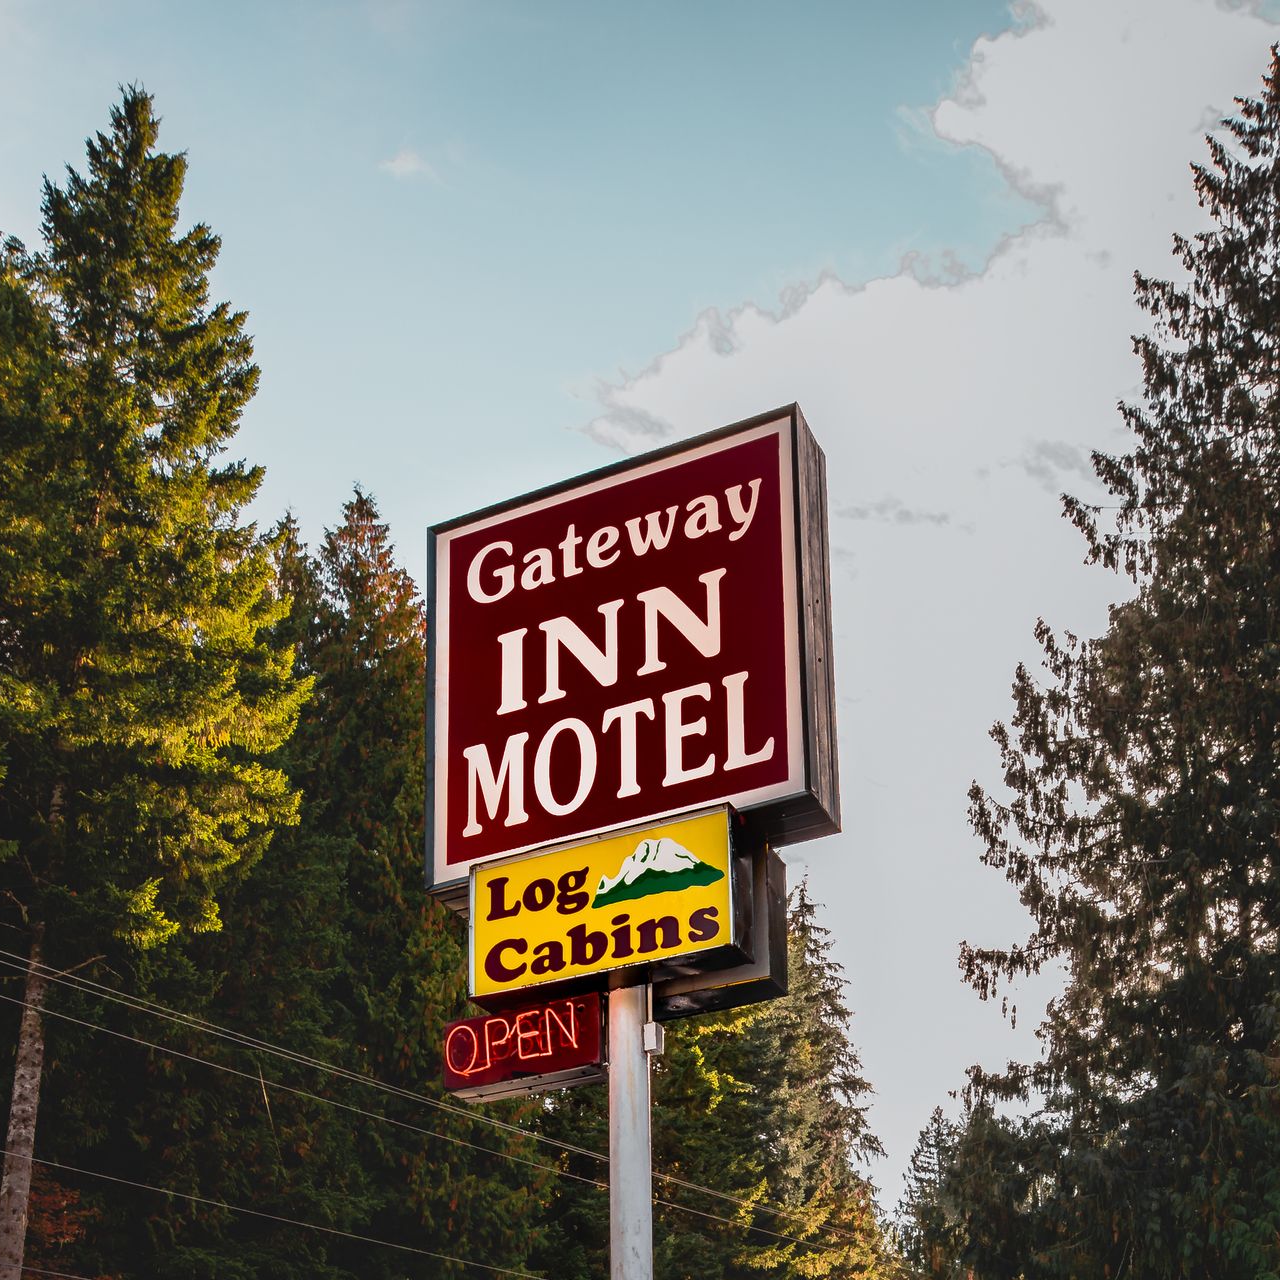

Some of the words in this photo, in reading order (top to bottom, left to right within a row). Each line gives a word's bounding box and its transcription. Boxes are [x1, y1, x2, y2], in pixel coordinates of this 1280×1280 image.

[466, 478, 762, 603] Gateway
[496, 568, 727, 716] INN
[462, 671, 775, 838] MOTEL
[484, 906, 720, 983] Cabins
[485, 866, 590, 922] Log
[446, 1002, 578, 1077] OPEN
